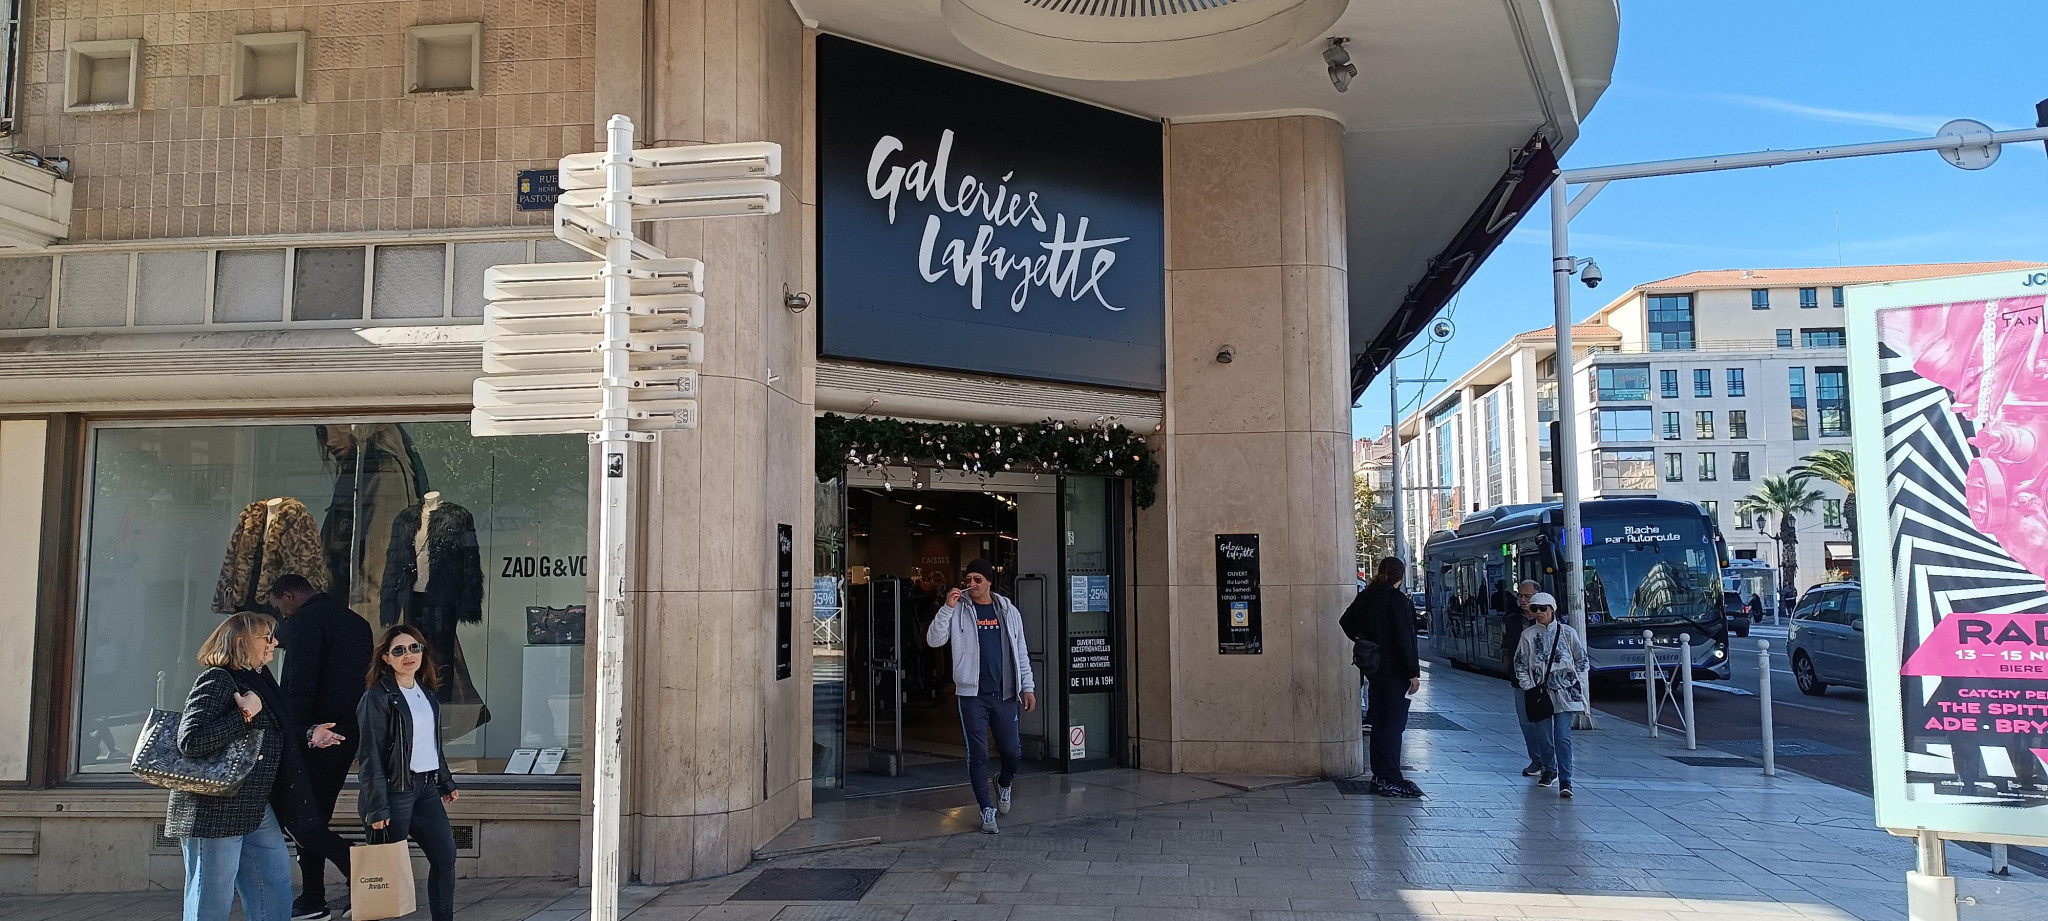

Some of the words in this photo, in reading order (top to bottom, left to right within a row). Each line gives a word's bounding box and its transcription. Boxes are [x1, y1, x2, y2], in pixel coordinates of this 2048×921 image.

[539, 174, 558, 184] RUE
[866, 128, 1047, 232] Galeries
[918, 212, 1131, 313] Lafayette
[2022, 272, 2048, 287] JC
[1623, 525, 1660, 535] Blache
[921, 556, 950, 564] CAISSES
[1088, 588, 1108, 600] -25%
[1076, 638, 1106, 646] OUVERTURES
[1617, 636, 1679, 645] HEUIEZ
[1071, 644, 1111, 653] EXCEPTIONNELLES
[1955, 649, 1977, 660] 13
[2000, 649, 2023, 661] 15
[1999, 664, 2044, 673] BIERE
[1070, 677, 1080, 687] DE
[1081, 676, 1094, 687] 11H
[1101, 675, 1114, 686] 19H
[1957, 688, 2021, 699] CATCHY
[2025, 690, 2048, 700] PE
[1937, 701, 1982, 714] THE
[1924, 716, 1979, 732] ADE
[368, 882, 390, 890] Avant
